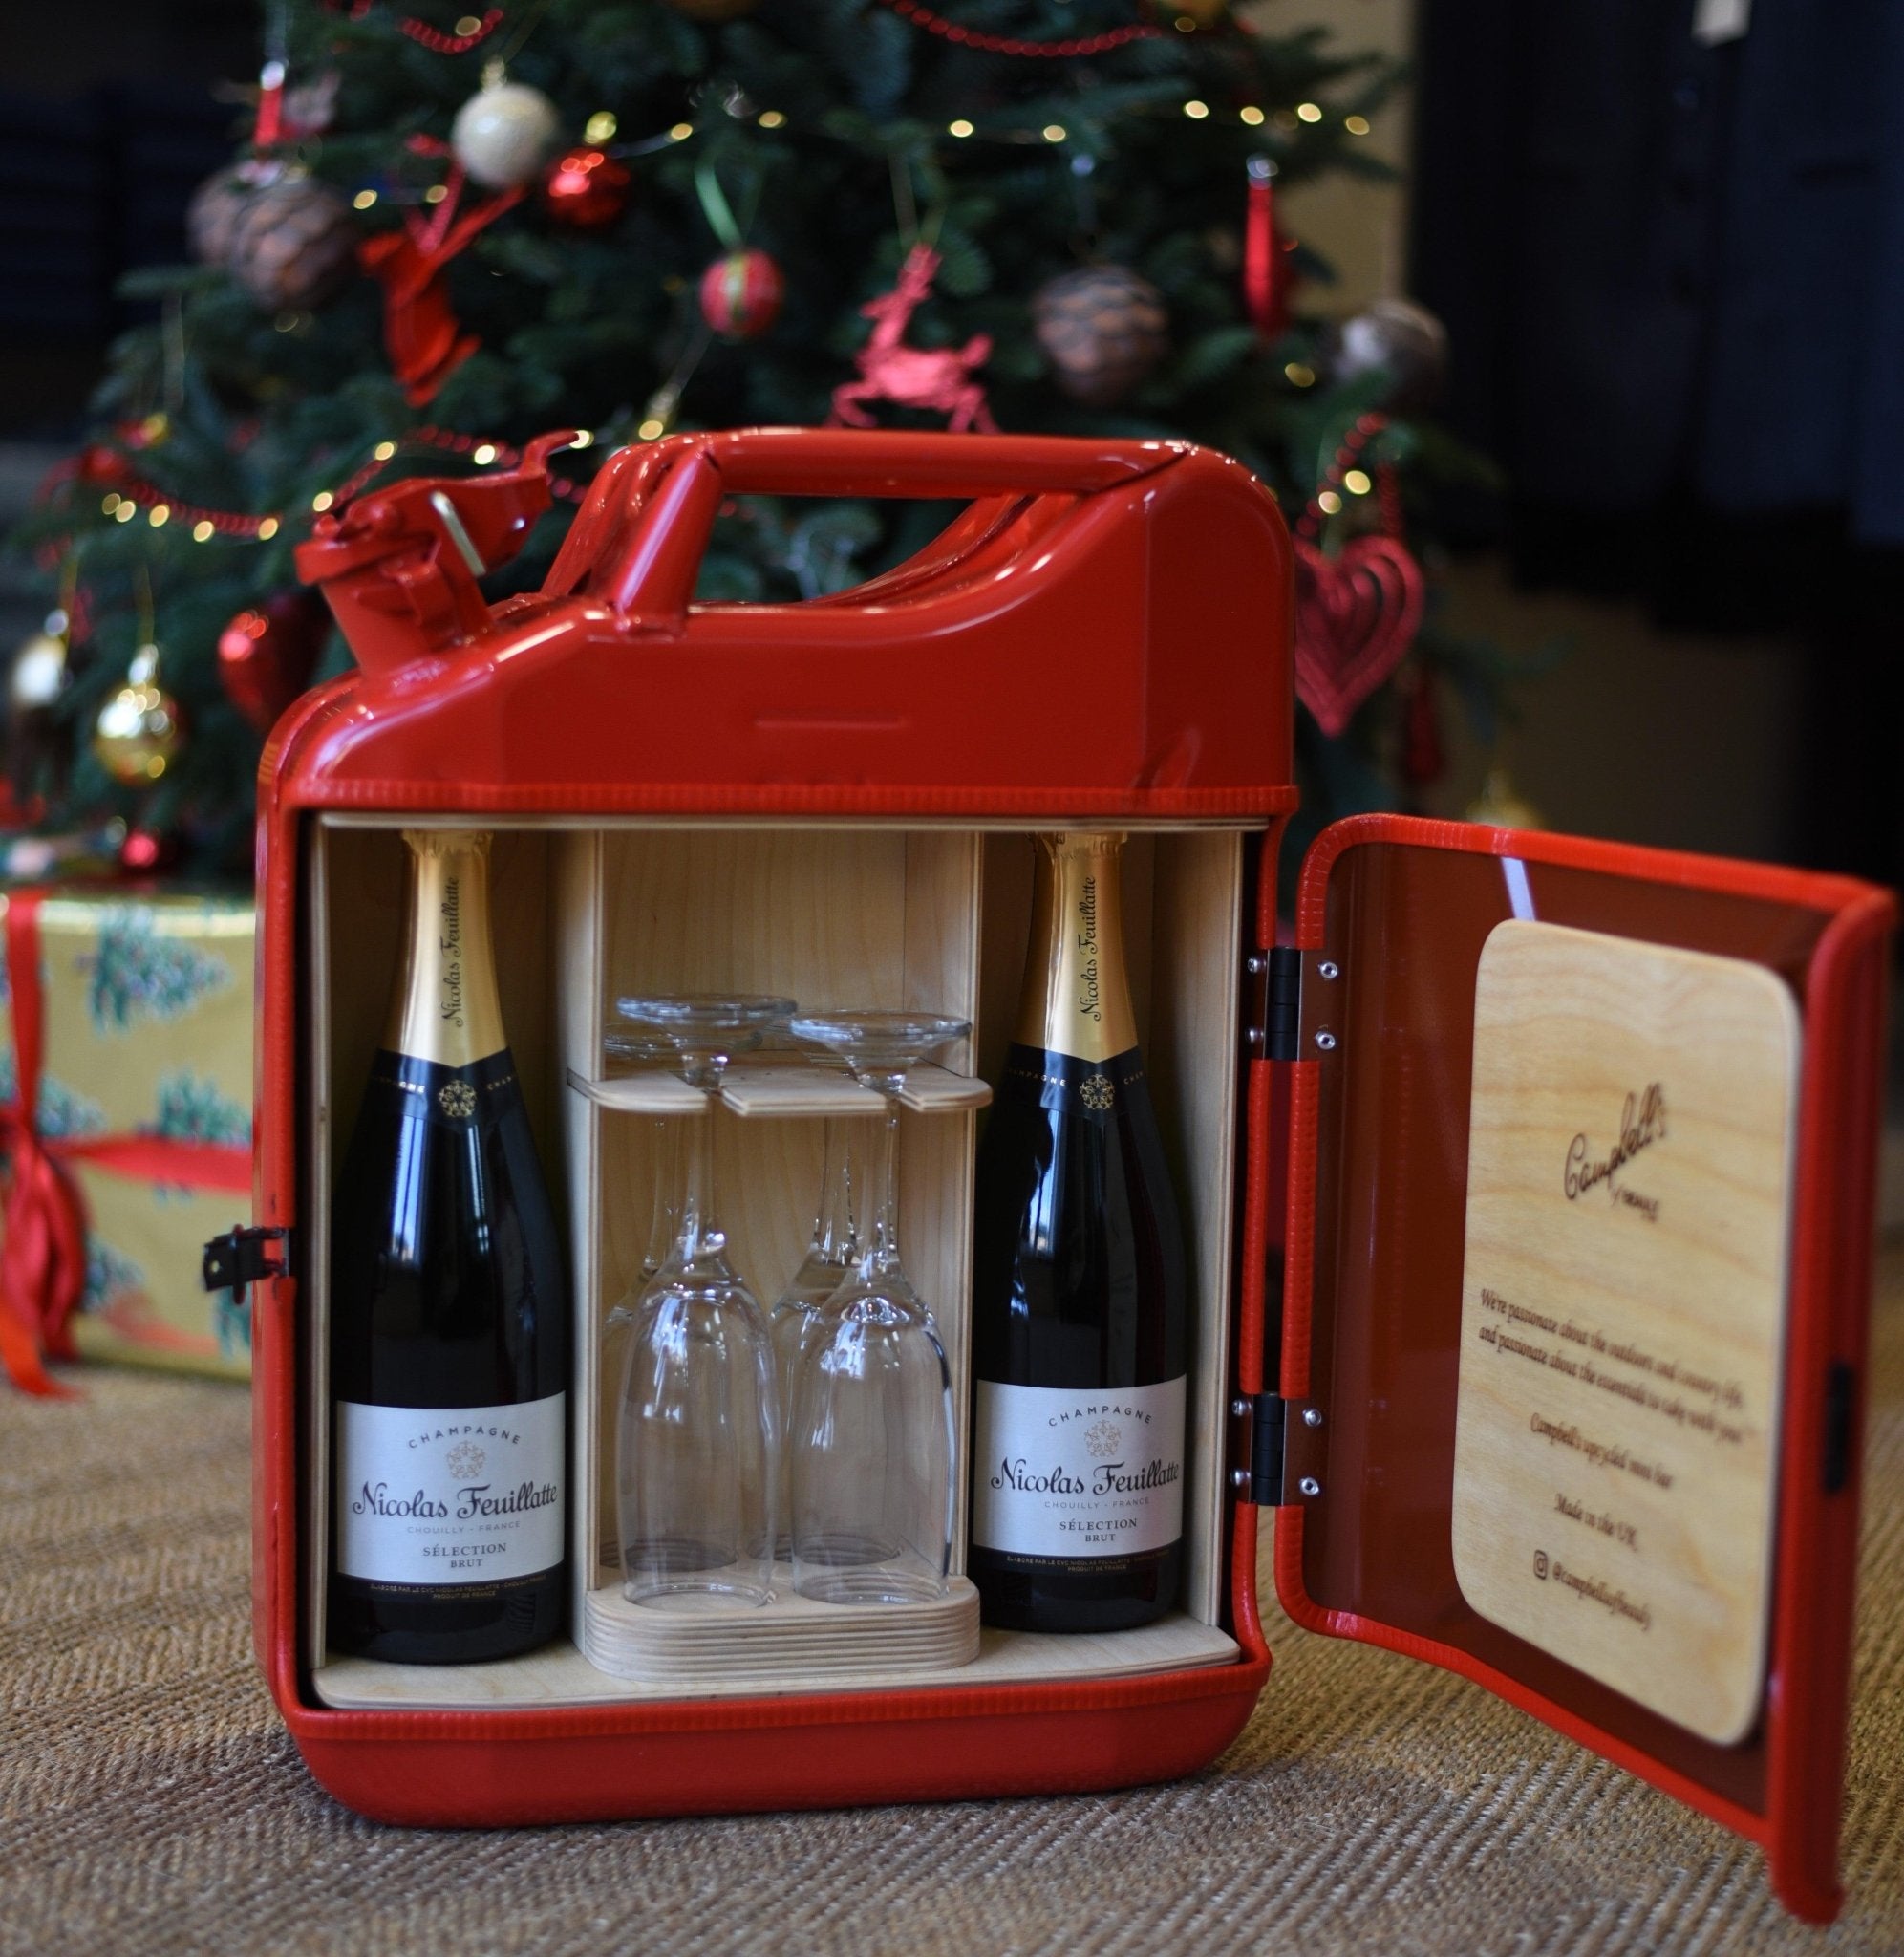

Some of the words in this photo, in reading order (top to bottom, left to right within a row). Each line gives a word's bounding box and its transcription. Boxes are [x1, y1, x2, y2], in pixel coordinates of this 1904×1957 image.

[440, 876, 460, 957] Feuillatte
[1078, 875, 1098, 956] Feuillatte
[442, 962, 463, 1028] Nicolas
[1080, 958, 1102, 1022] Nicolas
[1048, 1405, 1152, 1427] CHAMPAGNE
[408, 1425, 522, 1449] CHAMPAGNE
[991, 1456, 1085, 1494] Nicolas
[1092, 1458, 1180, 1495] Feuillatte
[352, 1480, 449, 1518] Nicolas
[456, 1480, 558, 1519] Feuillatte
[1112, 1497, 1150, 1508] FRANCE
[478, 1520, 521, 1532] FRANCE
[1059, 1517, 1138, 1531] SÉLECTION
[422, 1542, 508, 1557] SÉLECTION
[1084, 1534, 1117, 1542] BRUT
[449, 1558, 484, 1568] BRUT
